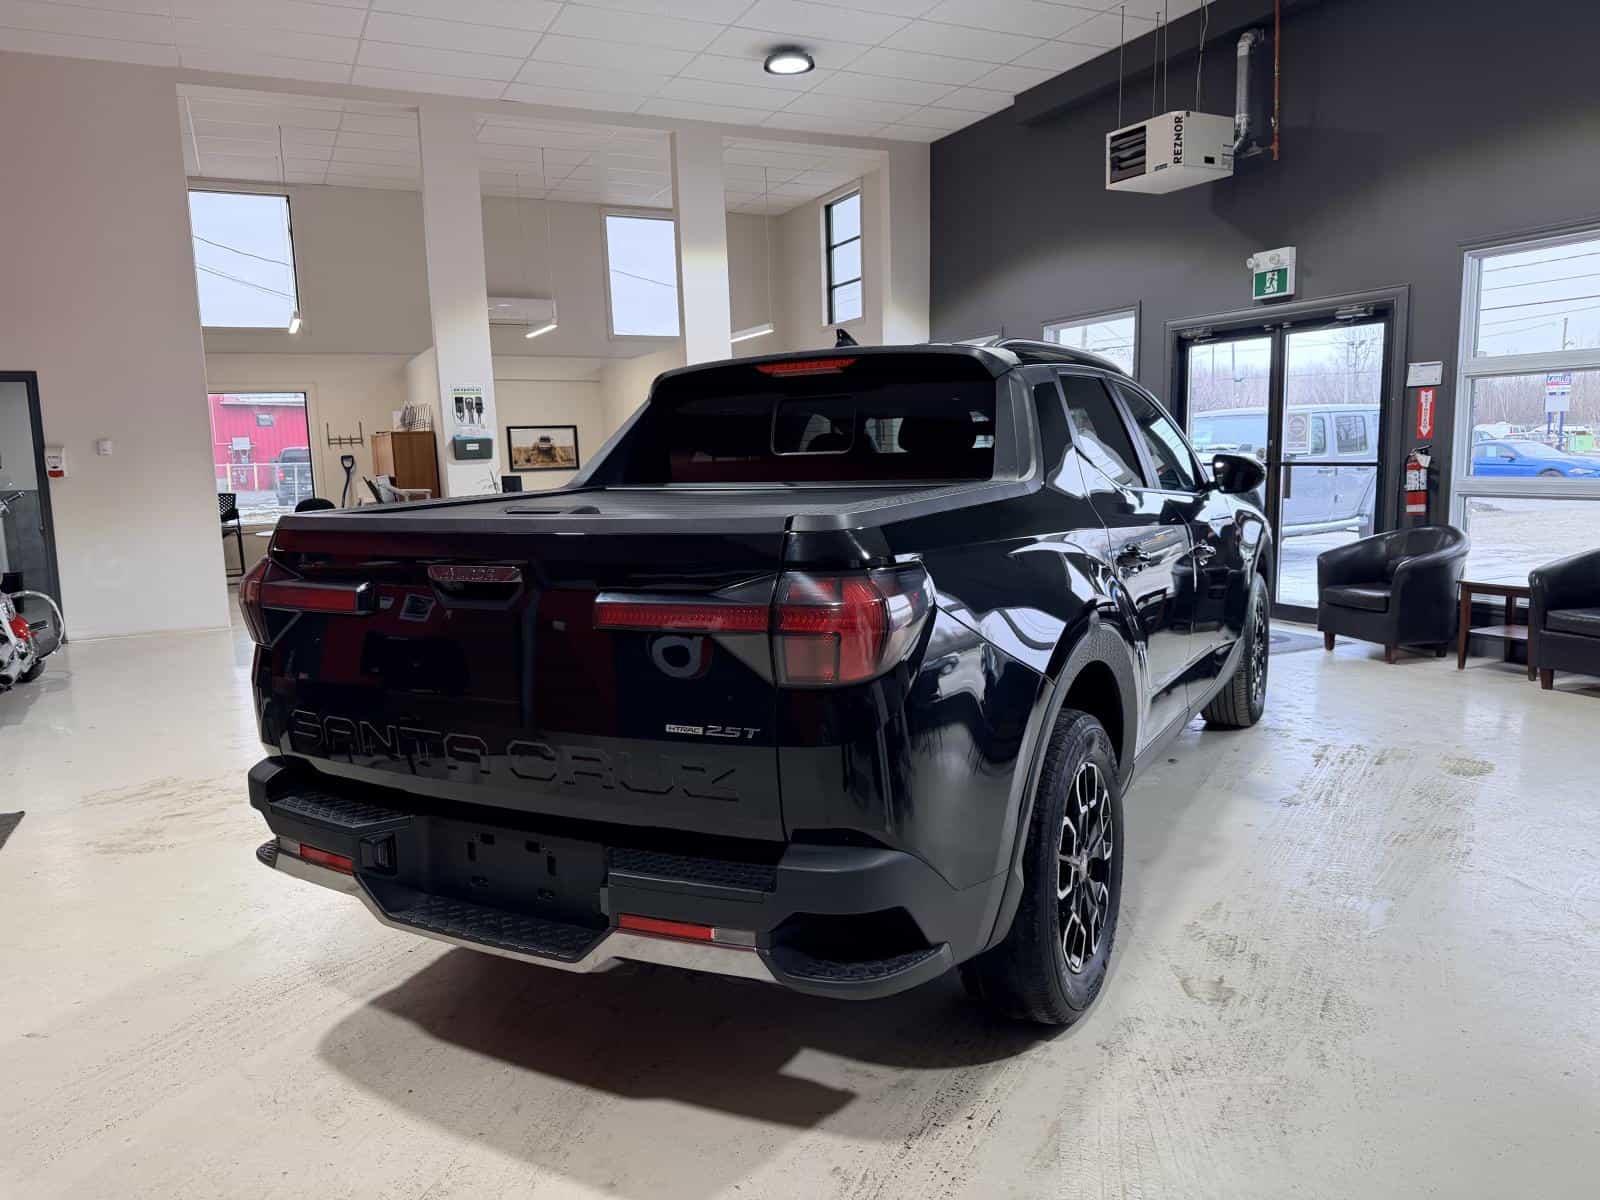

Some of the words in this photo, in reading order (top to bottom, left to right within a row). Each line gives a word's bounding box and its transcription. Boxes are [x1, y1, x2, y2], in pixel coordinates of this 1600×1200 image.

[1173, 115, 1184, 164] REZNOR
[291, 709, 492, 774] SANTA
[506, 738, 740, 802] CRUZ
